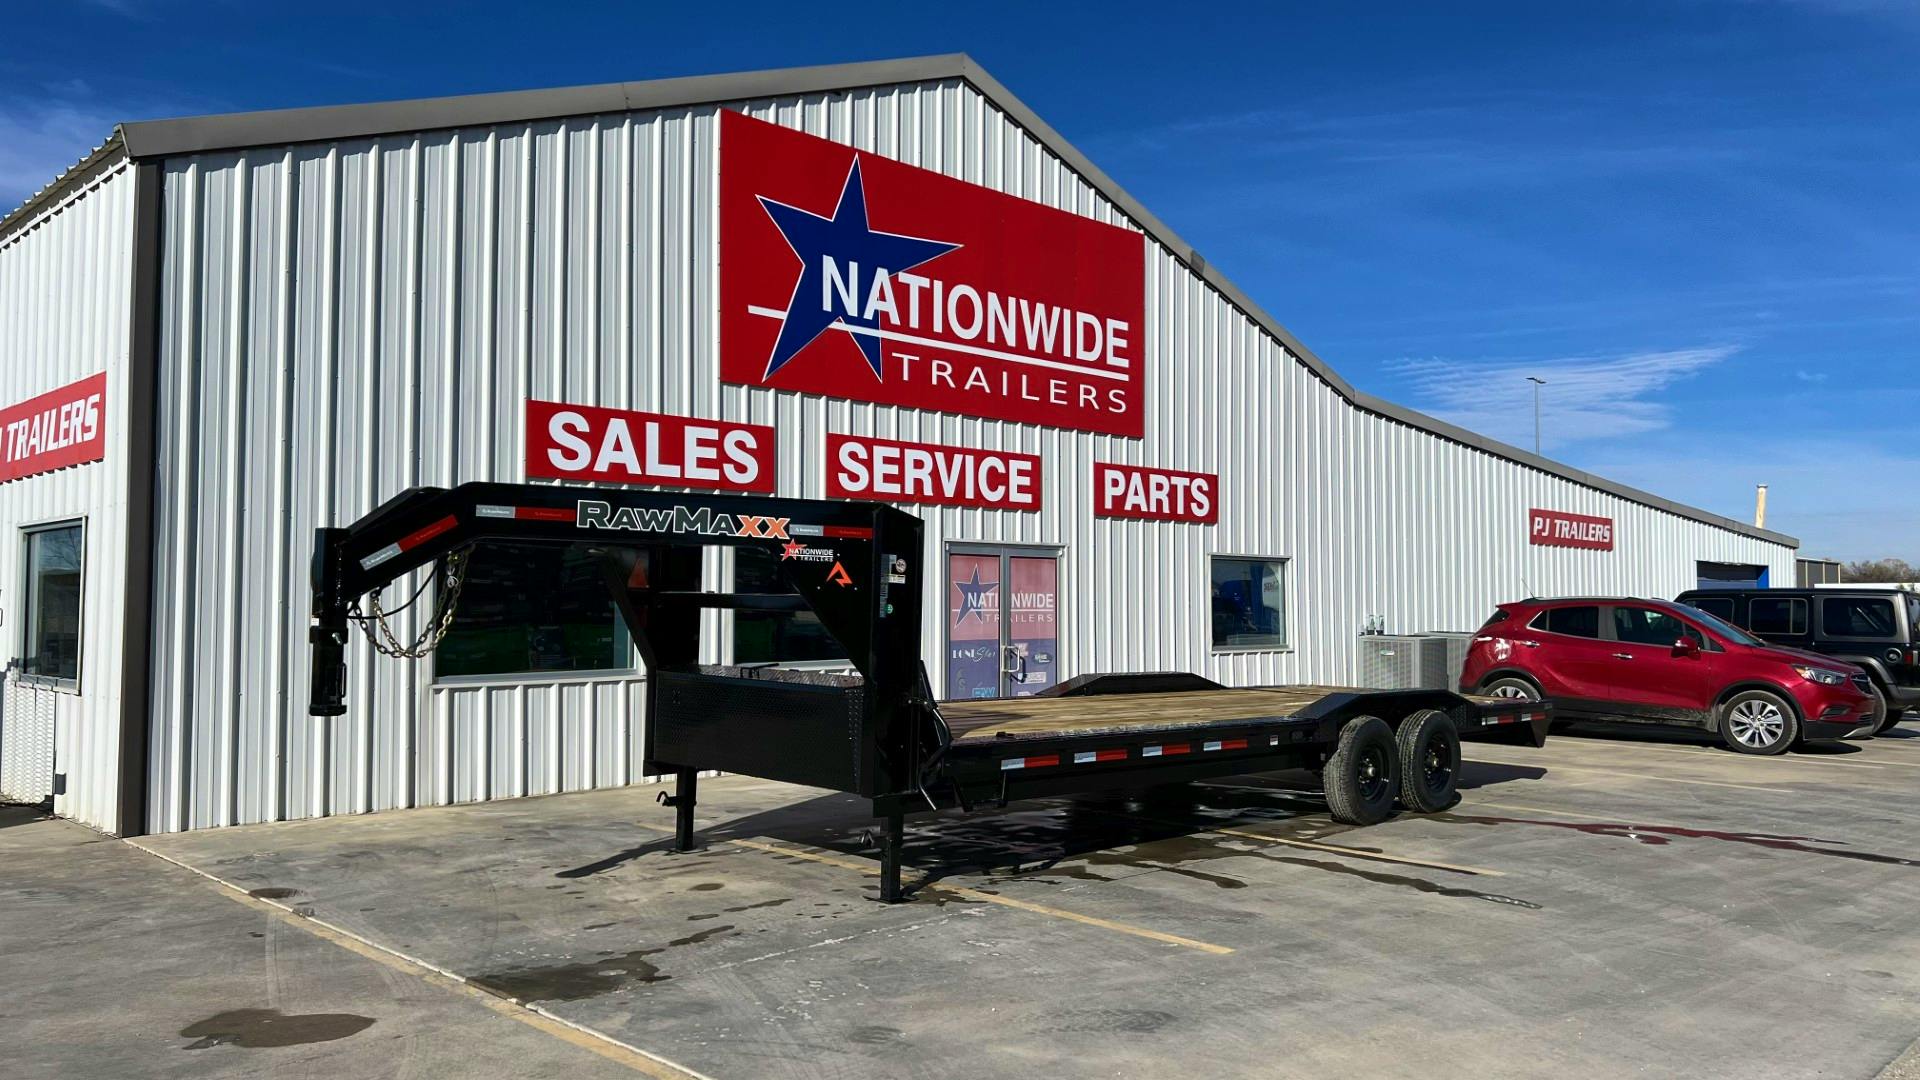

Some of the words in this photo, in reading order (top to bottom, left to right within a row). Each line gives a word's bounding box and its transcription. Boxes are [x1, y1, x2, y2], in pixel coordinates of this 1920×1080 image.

[822, 254, 1129, 368] NATIONWIDE
[892, 352, 1127, 413] TRAILERS
[6, 393, 101, 463] TRAILERS
[547, 411, 759, 484] SALES
[838, 442, 1032, 503] SERVICE
[1103, 469, 1210, 517] PARTS
[788, 547, 834, 557] NATIONWIDE
[1533, 516, 1550, 537] PJ
[1554, 519, 1611, 543] TRAILERS
[967, 592, 1054, 608] NATINWIDE
